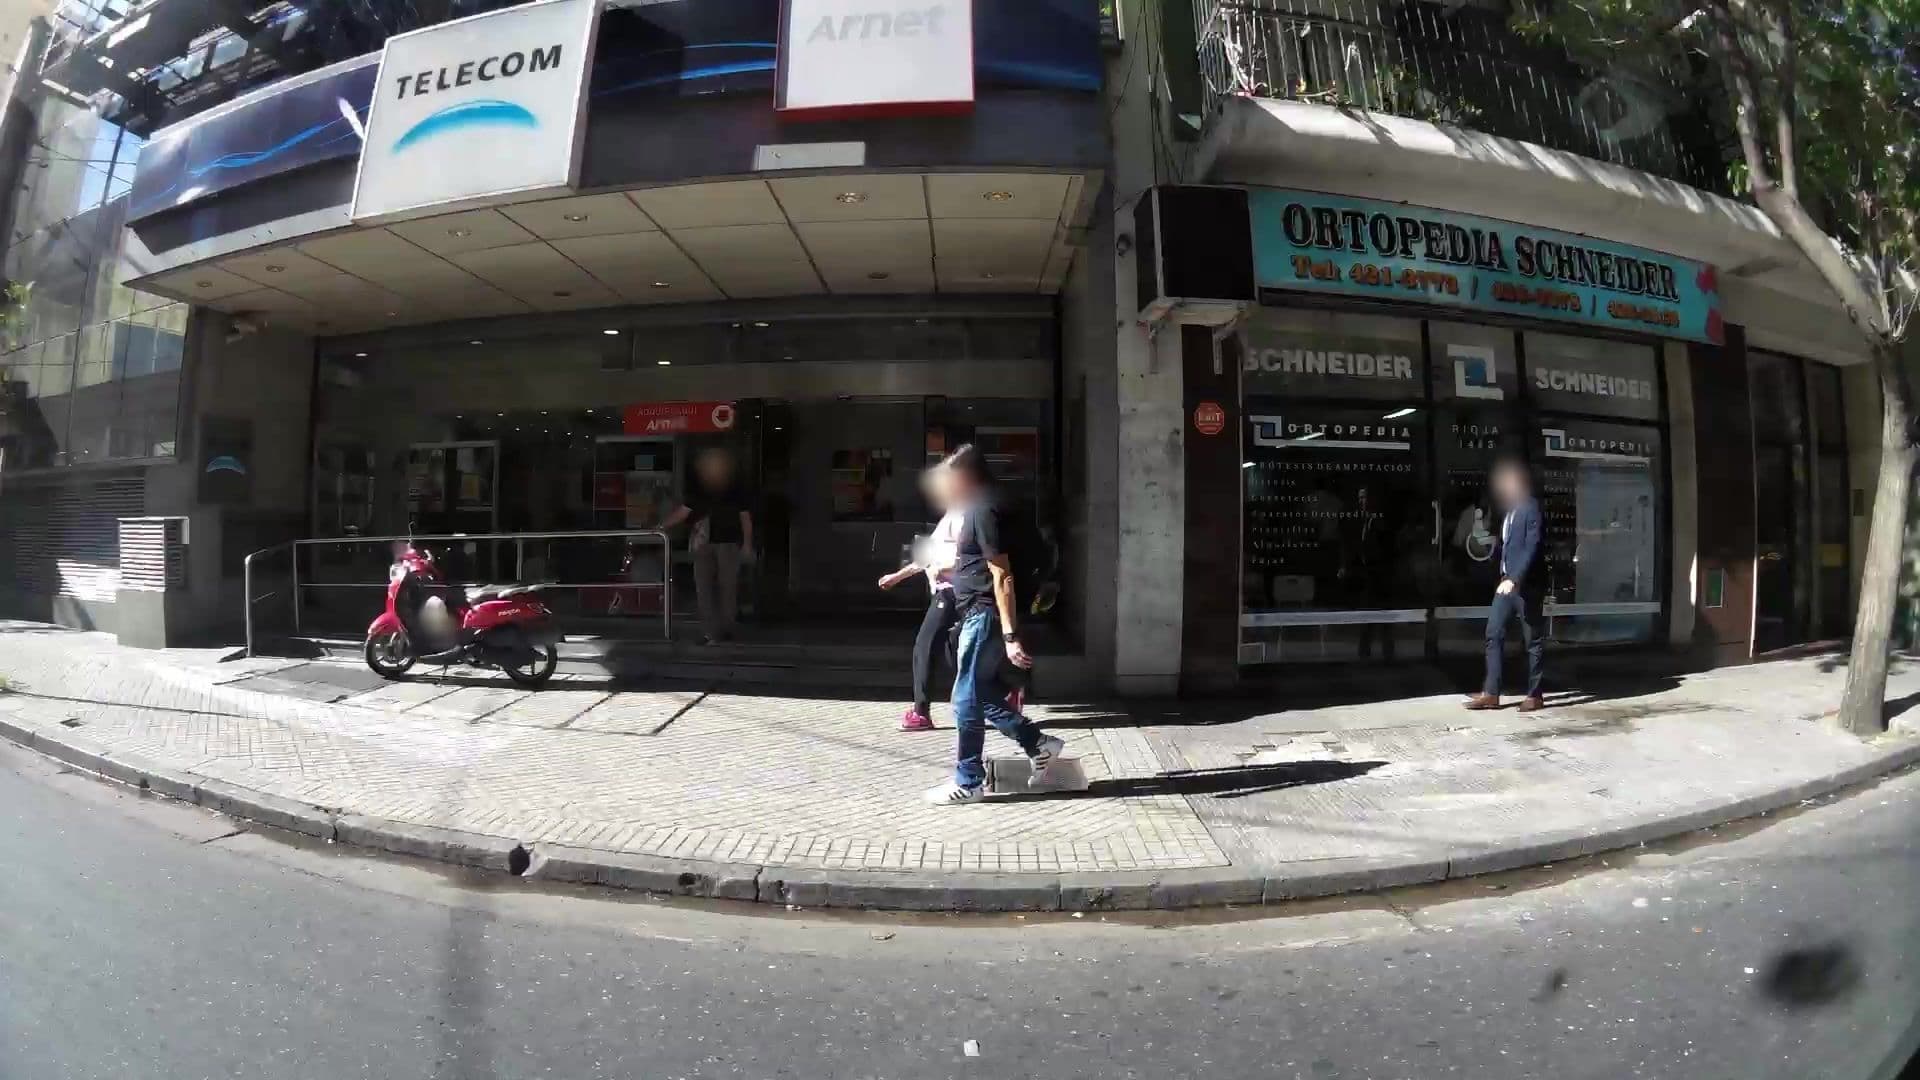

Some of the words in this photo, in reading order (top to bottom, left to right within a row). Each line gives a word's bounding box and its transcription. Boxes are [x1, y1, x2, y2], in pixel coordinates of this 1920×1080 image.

[806, 4, 946, 43] Arnet
[396, 44, 563, 100] TELECOM
[1282, 203, 1508, 272] ORTOPEDIA
[1514, 235, 1680, 302] SCHNEIDER
[1243, 349, 1413, 379] SCHNEIDER
[1535, 367, 1652, 401] SCHNEIDER
[1287, 423, 1411, 438] ORTOPEDIA
